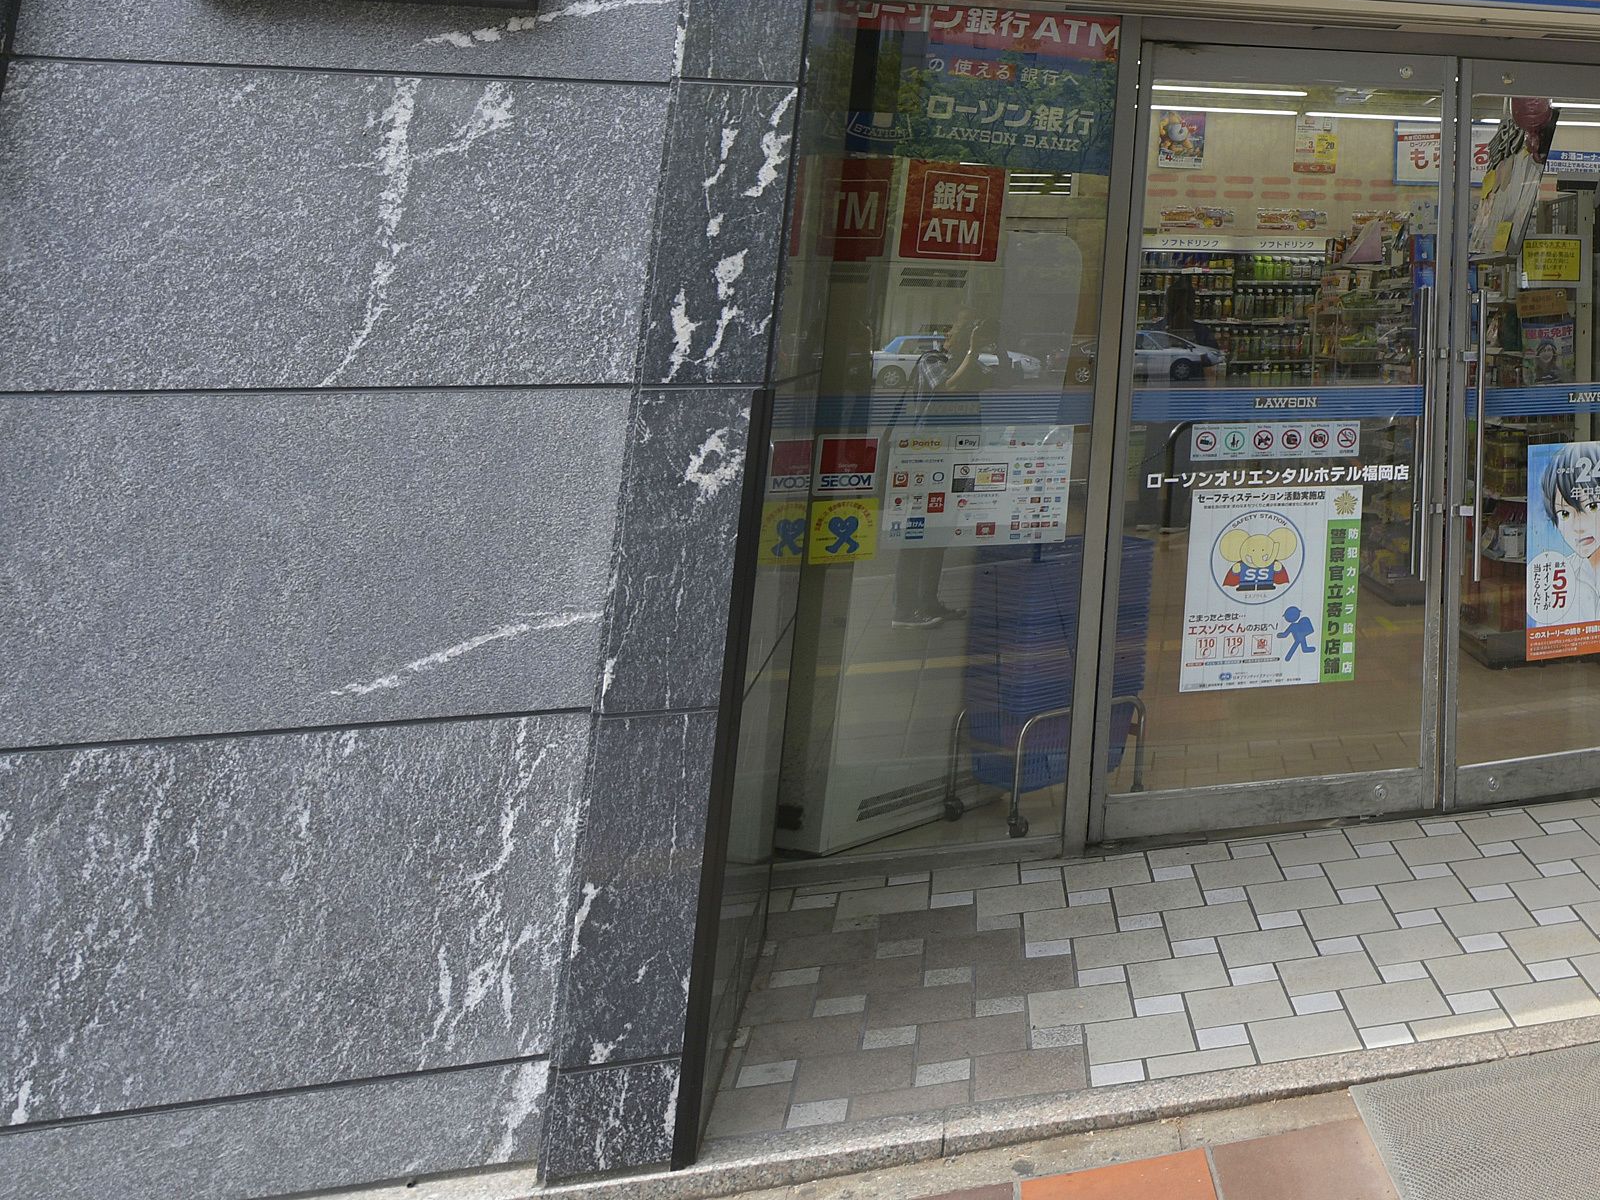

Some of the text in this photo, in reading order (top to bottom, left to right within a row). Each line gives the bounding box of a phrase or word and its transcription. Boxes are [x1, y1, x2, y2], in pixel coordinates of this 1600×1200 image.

[927, 95, 1095, 136] ローソン銀行
[935, 125, 1081, 152] LAWSON BANK
[933, 180, 979, 213] 銀行
[923, 217, 980, 246] ATM
[1161, 238, 1220, 248] ソフトドリンク
[1259, 240, 1315, 250] ソフトドリンク
[1254, 397, 1318, 409] LAWSON
[912, 439, 941, 448] Ponta
[964, 438, 977, 448] Pay
[820, 475, 872, 488] SECOM
[1146, 465, 1411, 490] ローソンオリエンタルホテル福岡店
[1197, 489, 1326, 505] セーフティステーション活動実施店
[1231, 513, 1288, 529] SAFETY STATION
[1244, 568, 1270, 581] SS
[1532, 563, 1542, 614] 当たるんだ!
[1542, 561, 1552, 611] ポイントが
[1551, 568, 1568, 609] 5万
[1323, 527, 1347, 676] 警察官立寄り店舗
[1197, 638, 1216, 649] 110
[1225, 636, 1243, 648] 119
